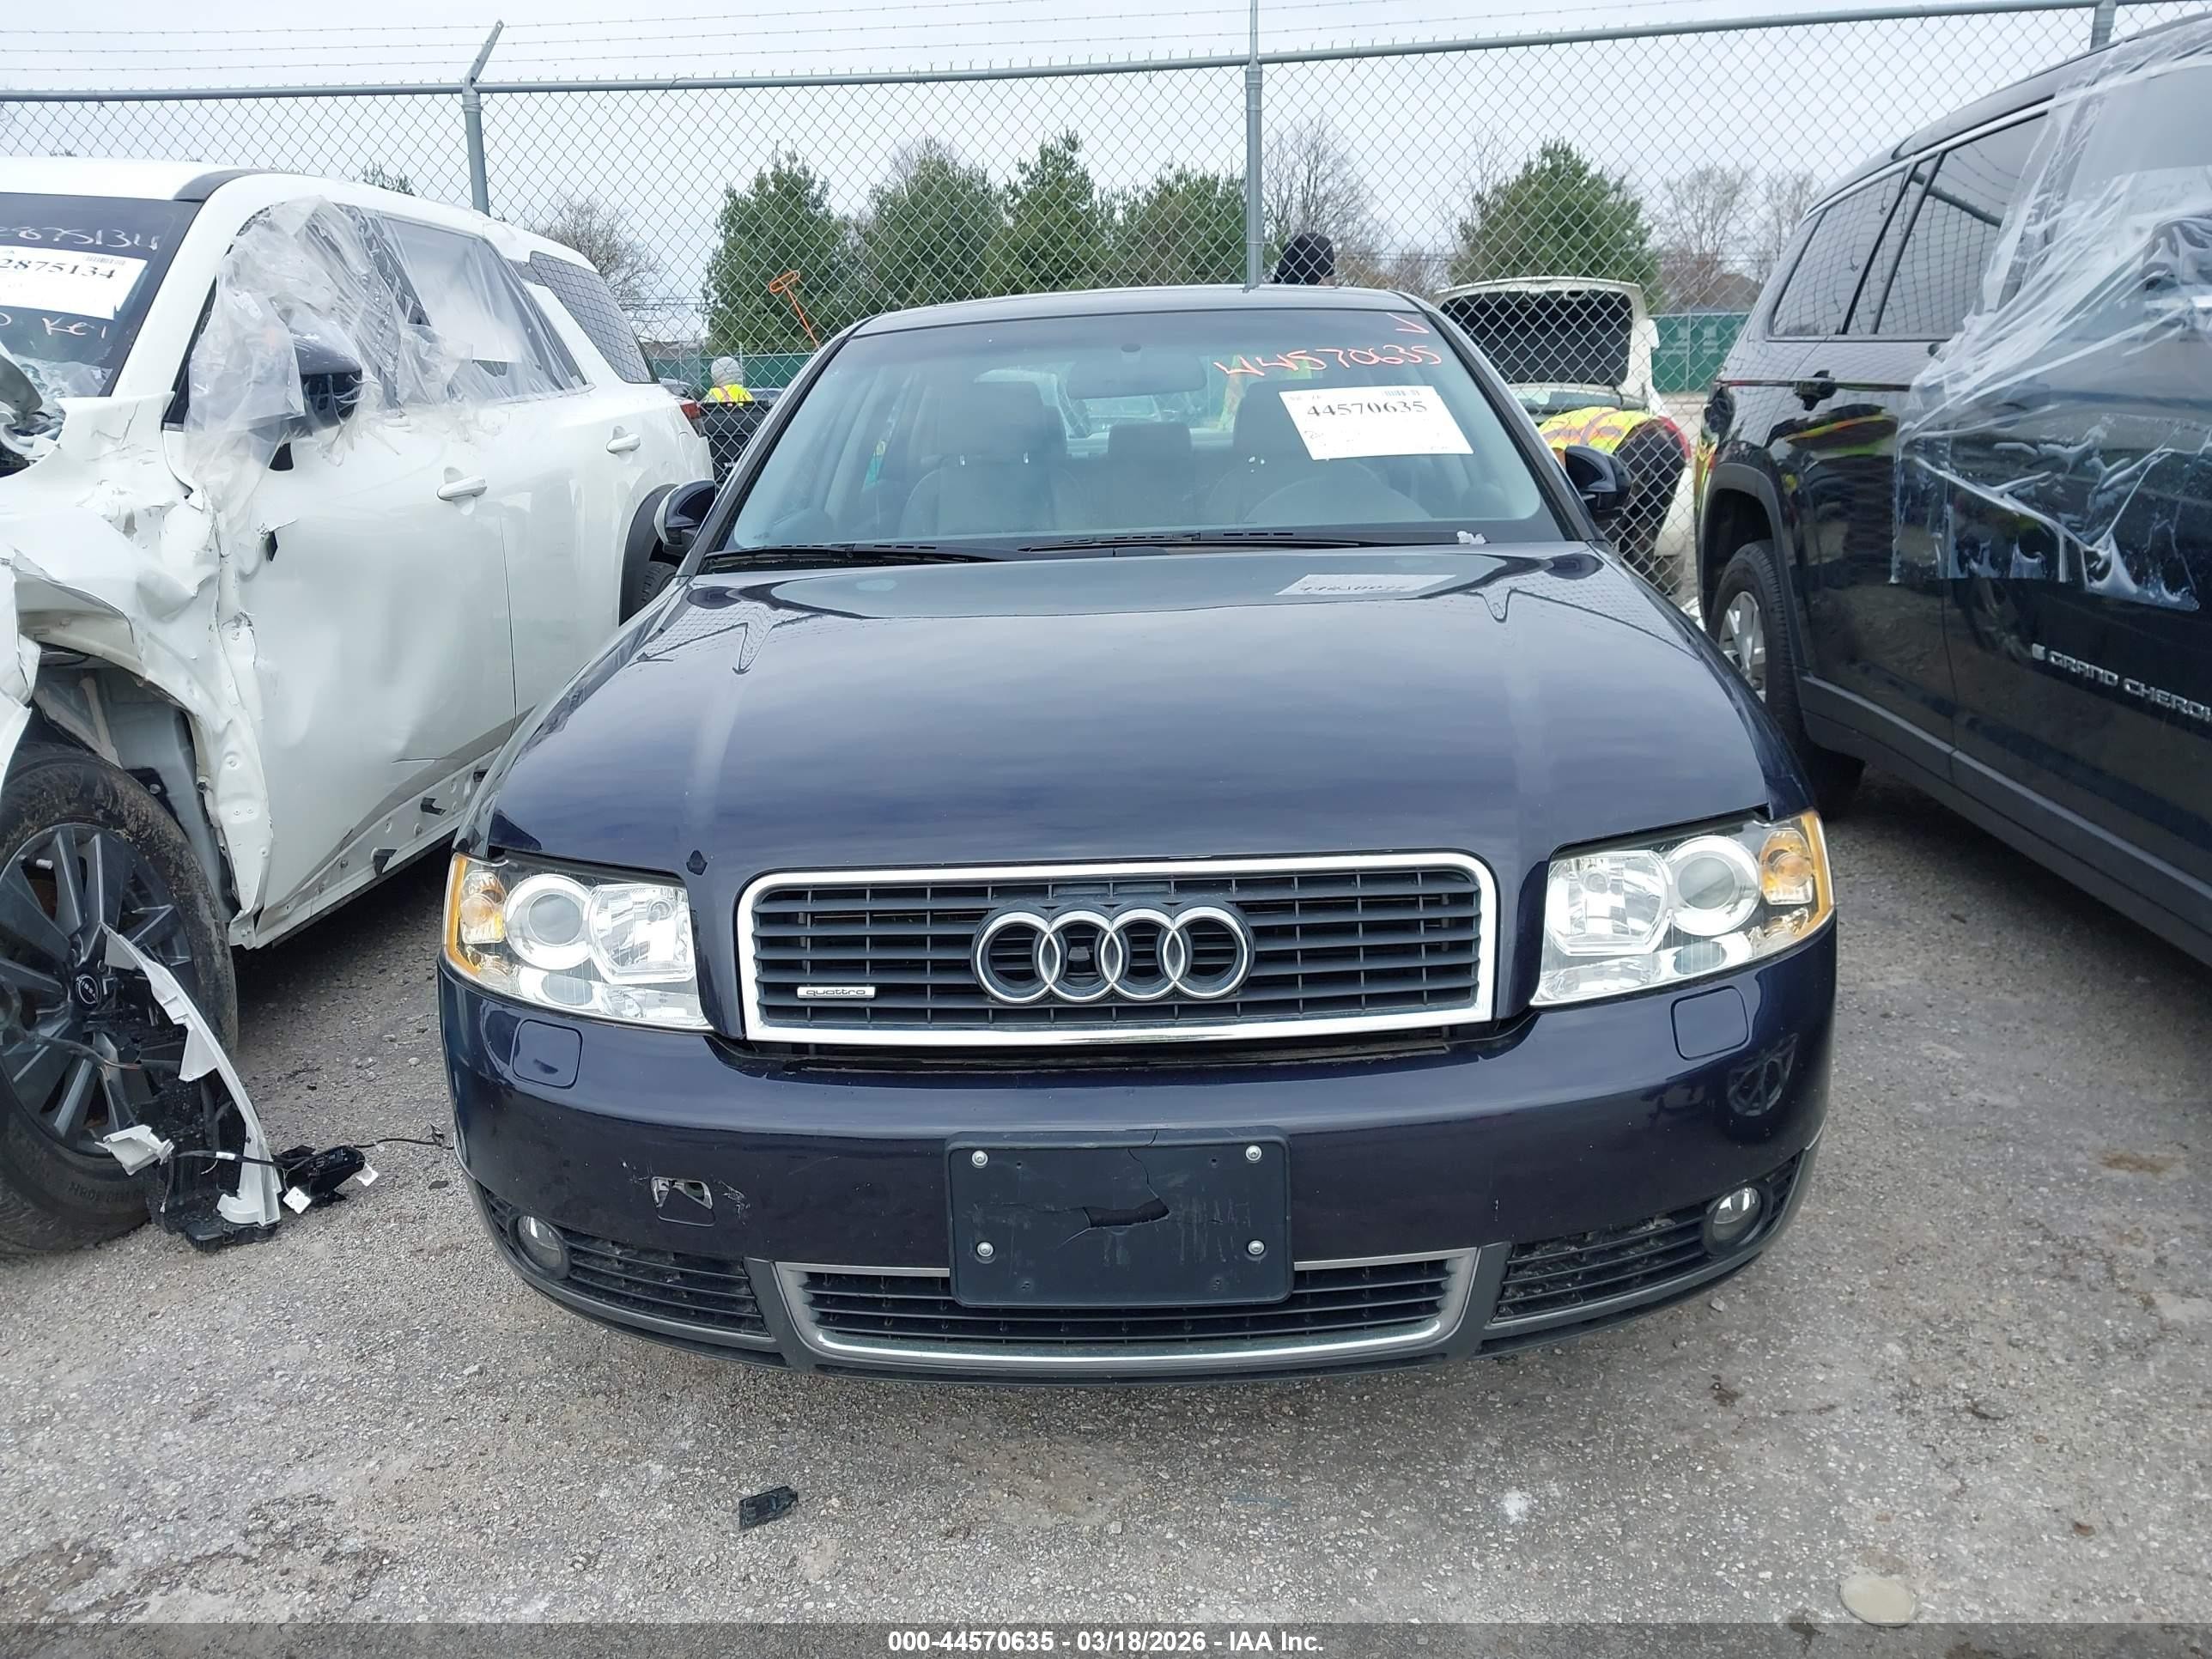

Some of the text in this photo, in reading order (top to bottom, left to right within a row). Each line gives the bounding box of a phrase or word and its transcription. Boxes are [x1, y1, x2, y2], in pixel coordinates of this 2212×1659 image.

[1212, 344, 1443, 376] 44570635
[1306, 399, 1429, 417] 44570635
[2049, 650, 2118, 687] GRAND
[805, 988, 866, 997] quattro
